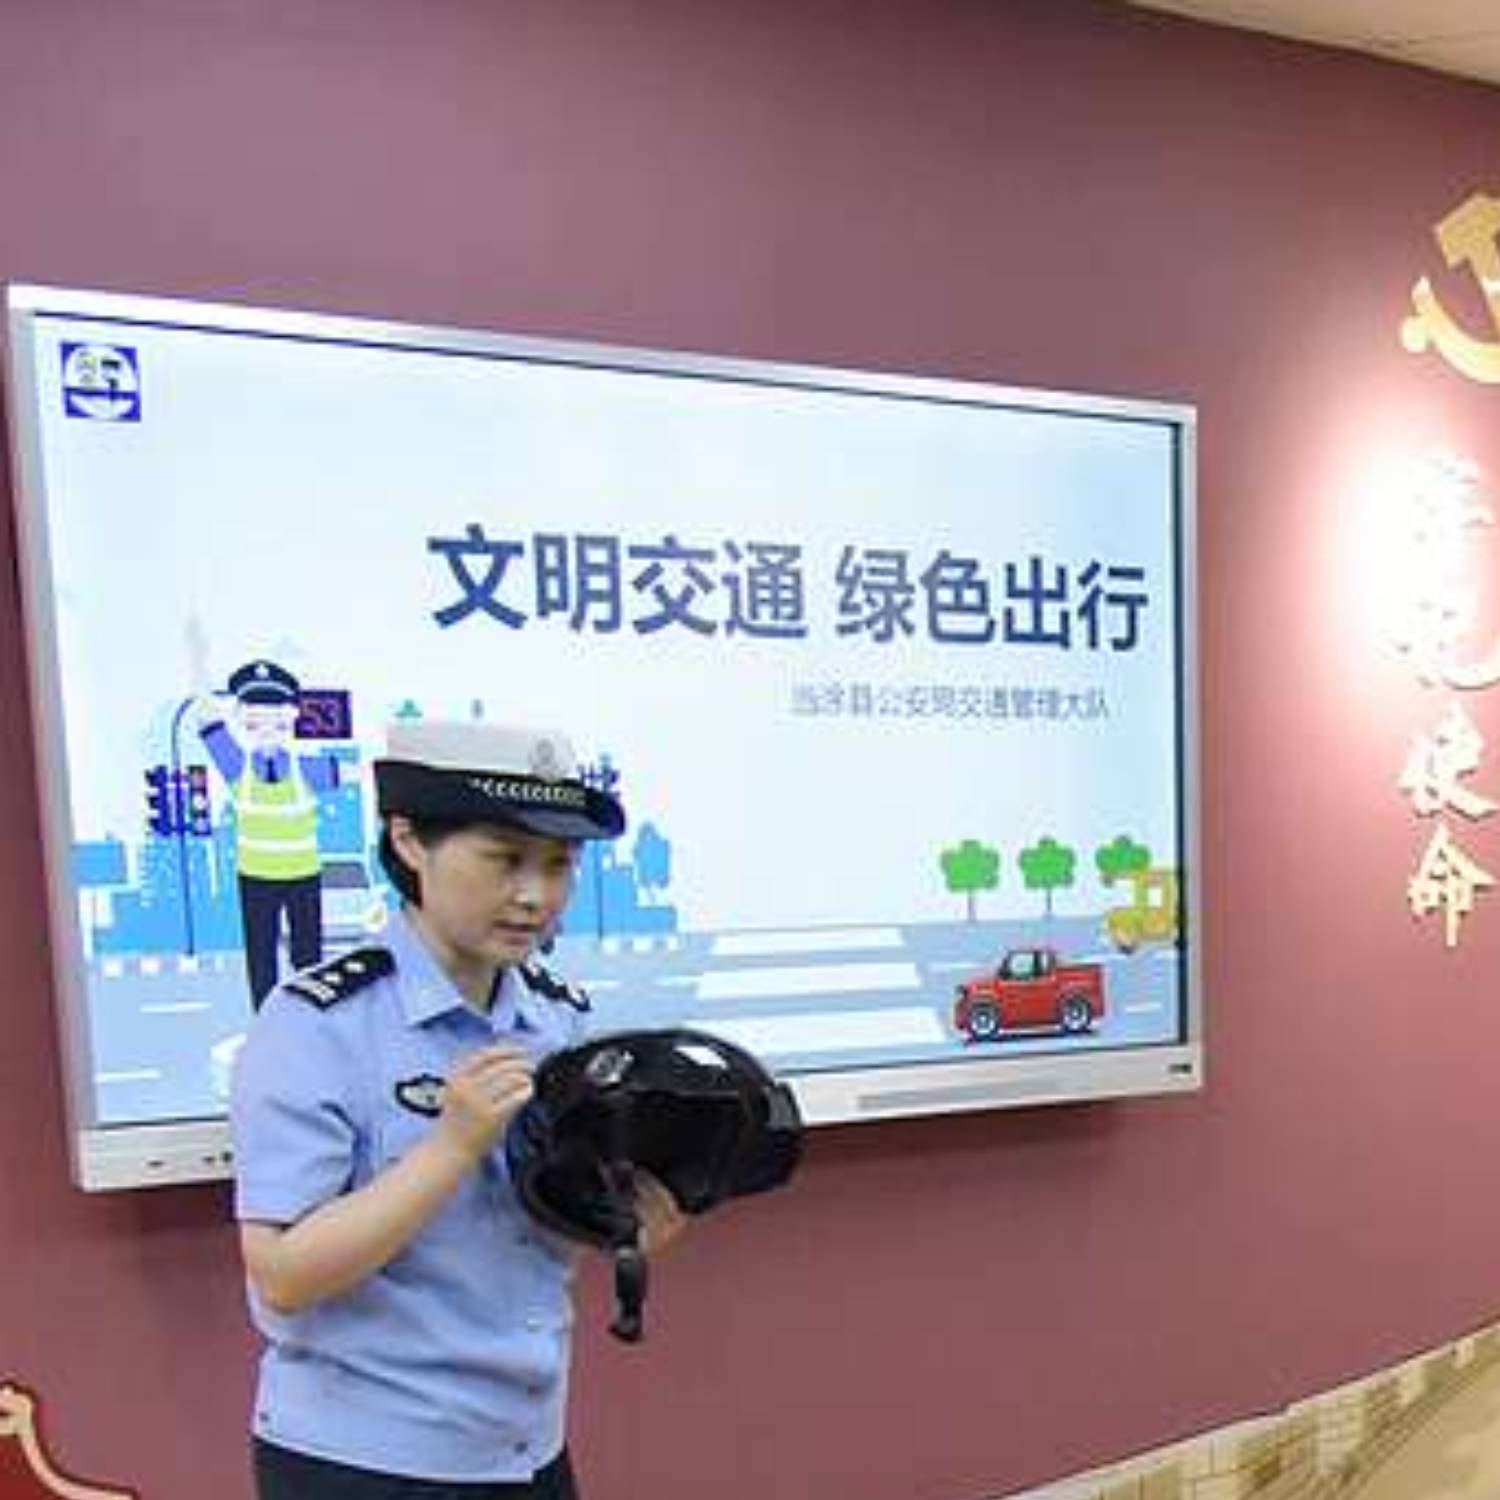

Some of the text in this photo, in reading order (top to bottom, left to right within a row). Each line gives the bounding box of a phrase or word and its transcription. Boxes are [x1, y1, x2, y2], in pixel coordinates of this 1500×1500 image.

[427, 523, 1149, 652] 文明交通 绿色出行
